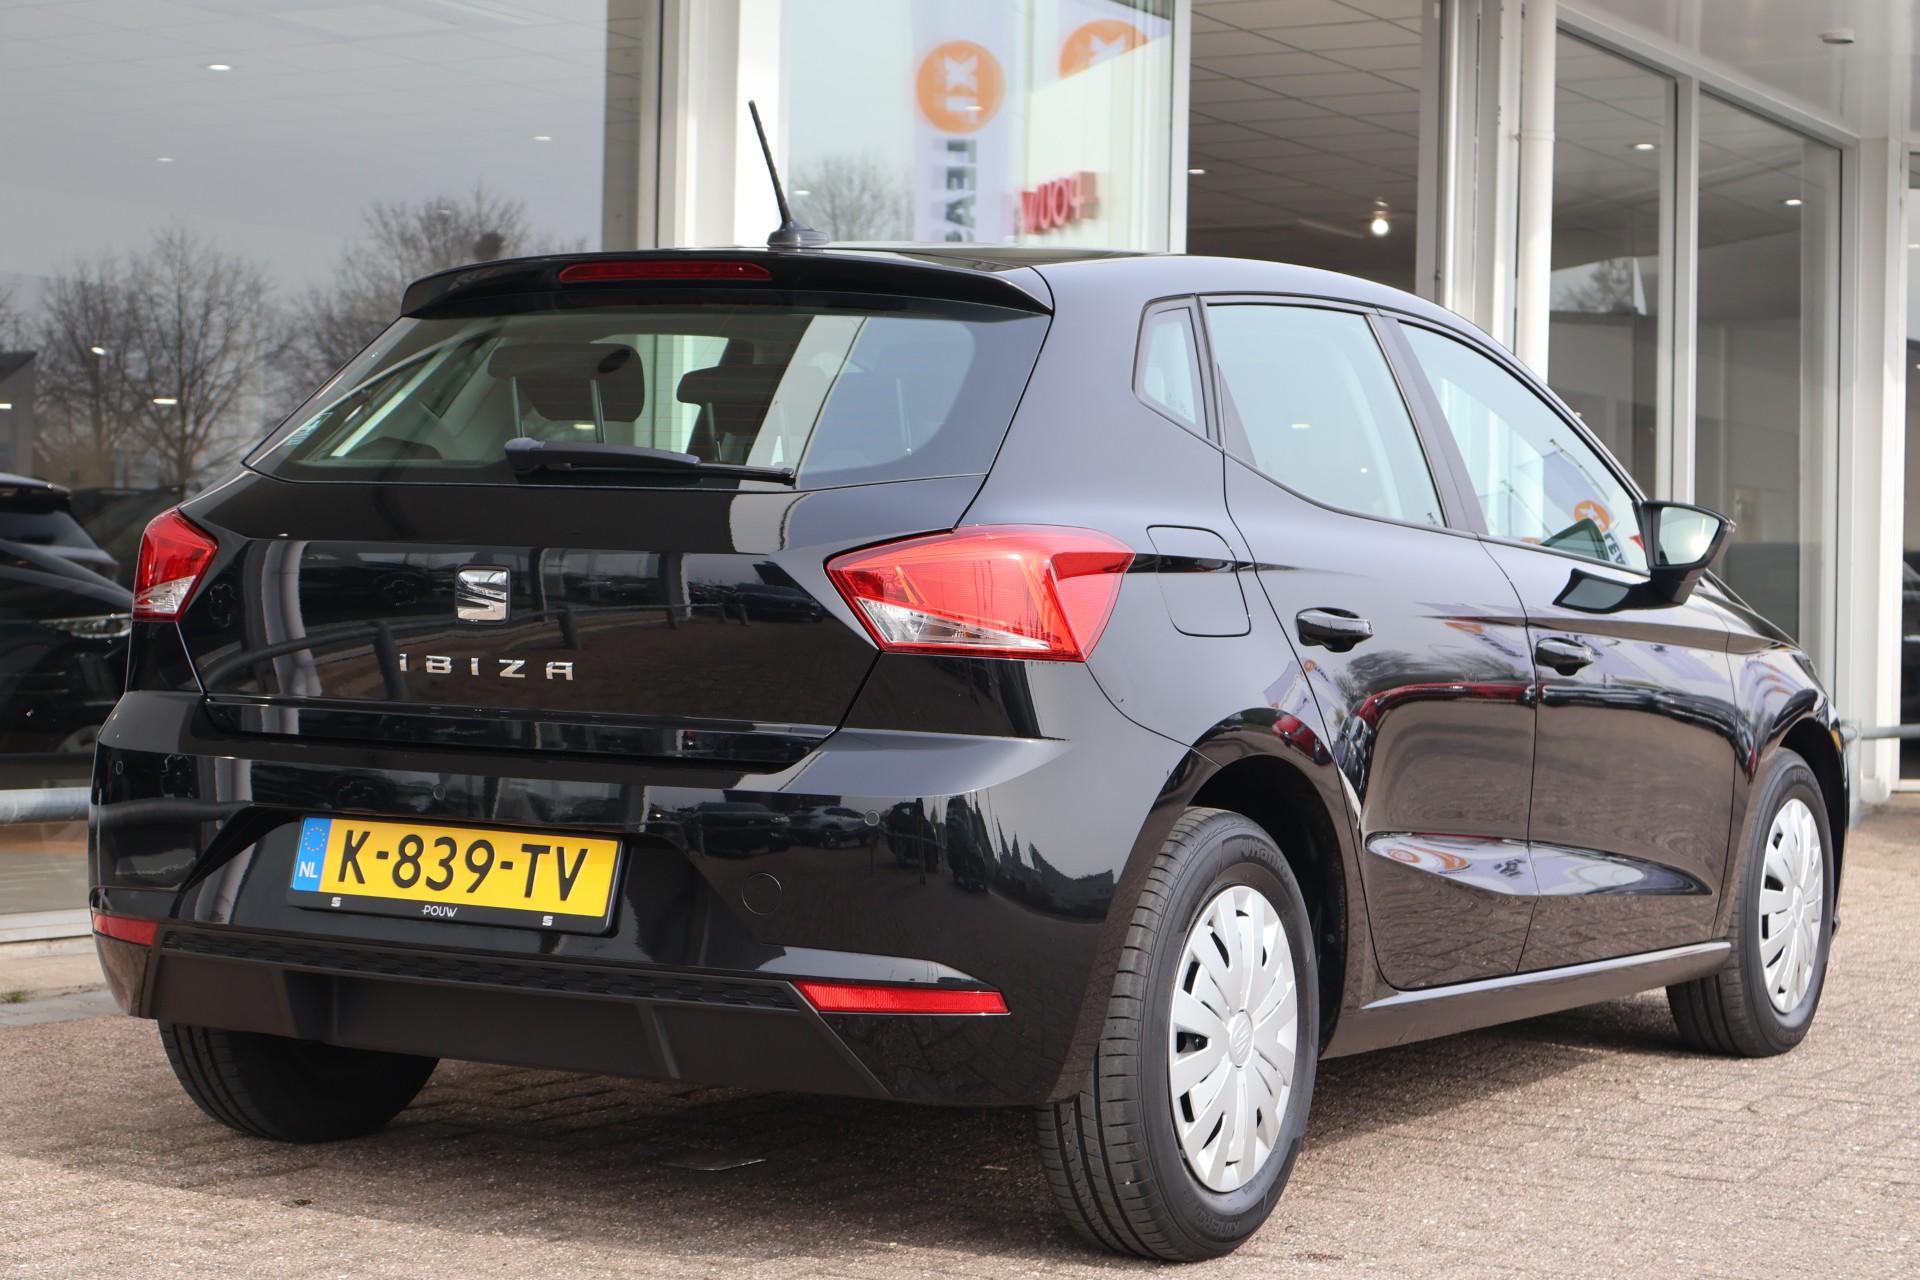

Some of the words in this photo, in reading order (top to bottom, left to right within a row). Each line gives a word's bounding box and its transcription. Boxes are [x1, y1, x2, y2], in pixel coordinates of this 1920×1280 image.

[399, 653, 576, 681] IBIZA
[298, 860, 319, 879] NL
[337, 829, 589, 902] K-839-TV
[421, 904, 458, 918] POUW
